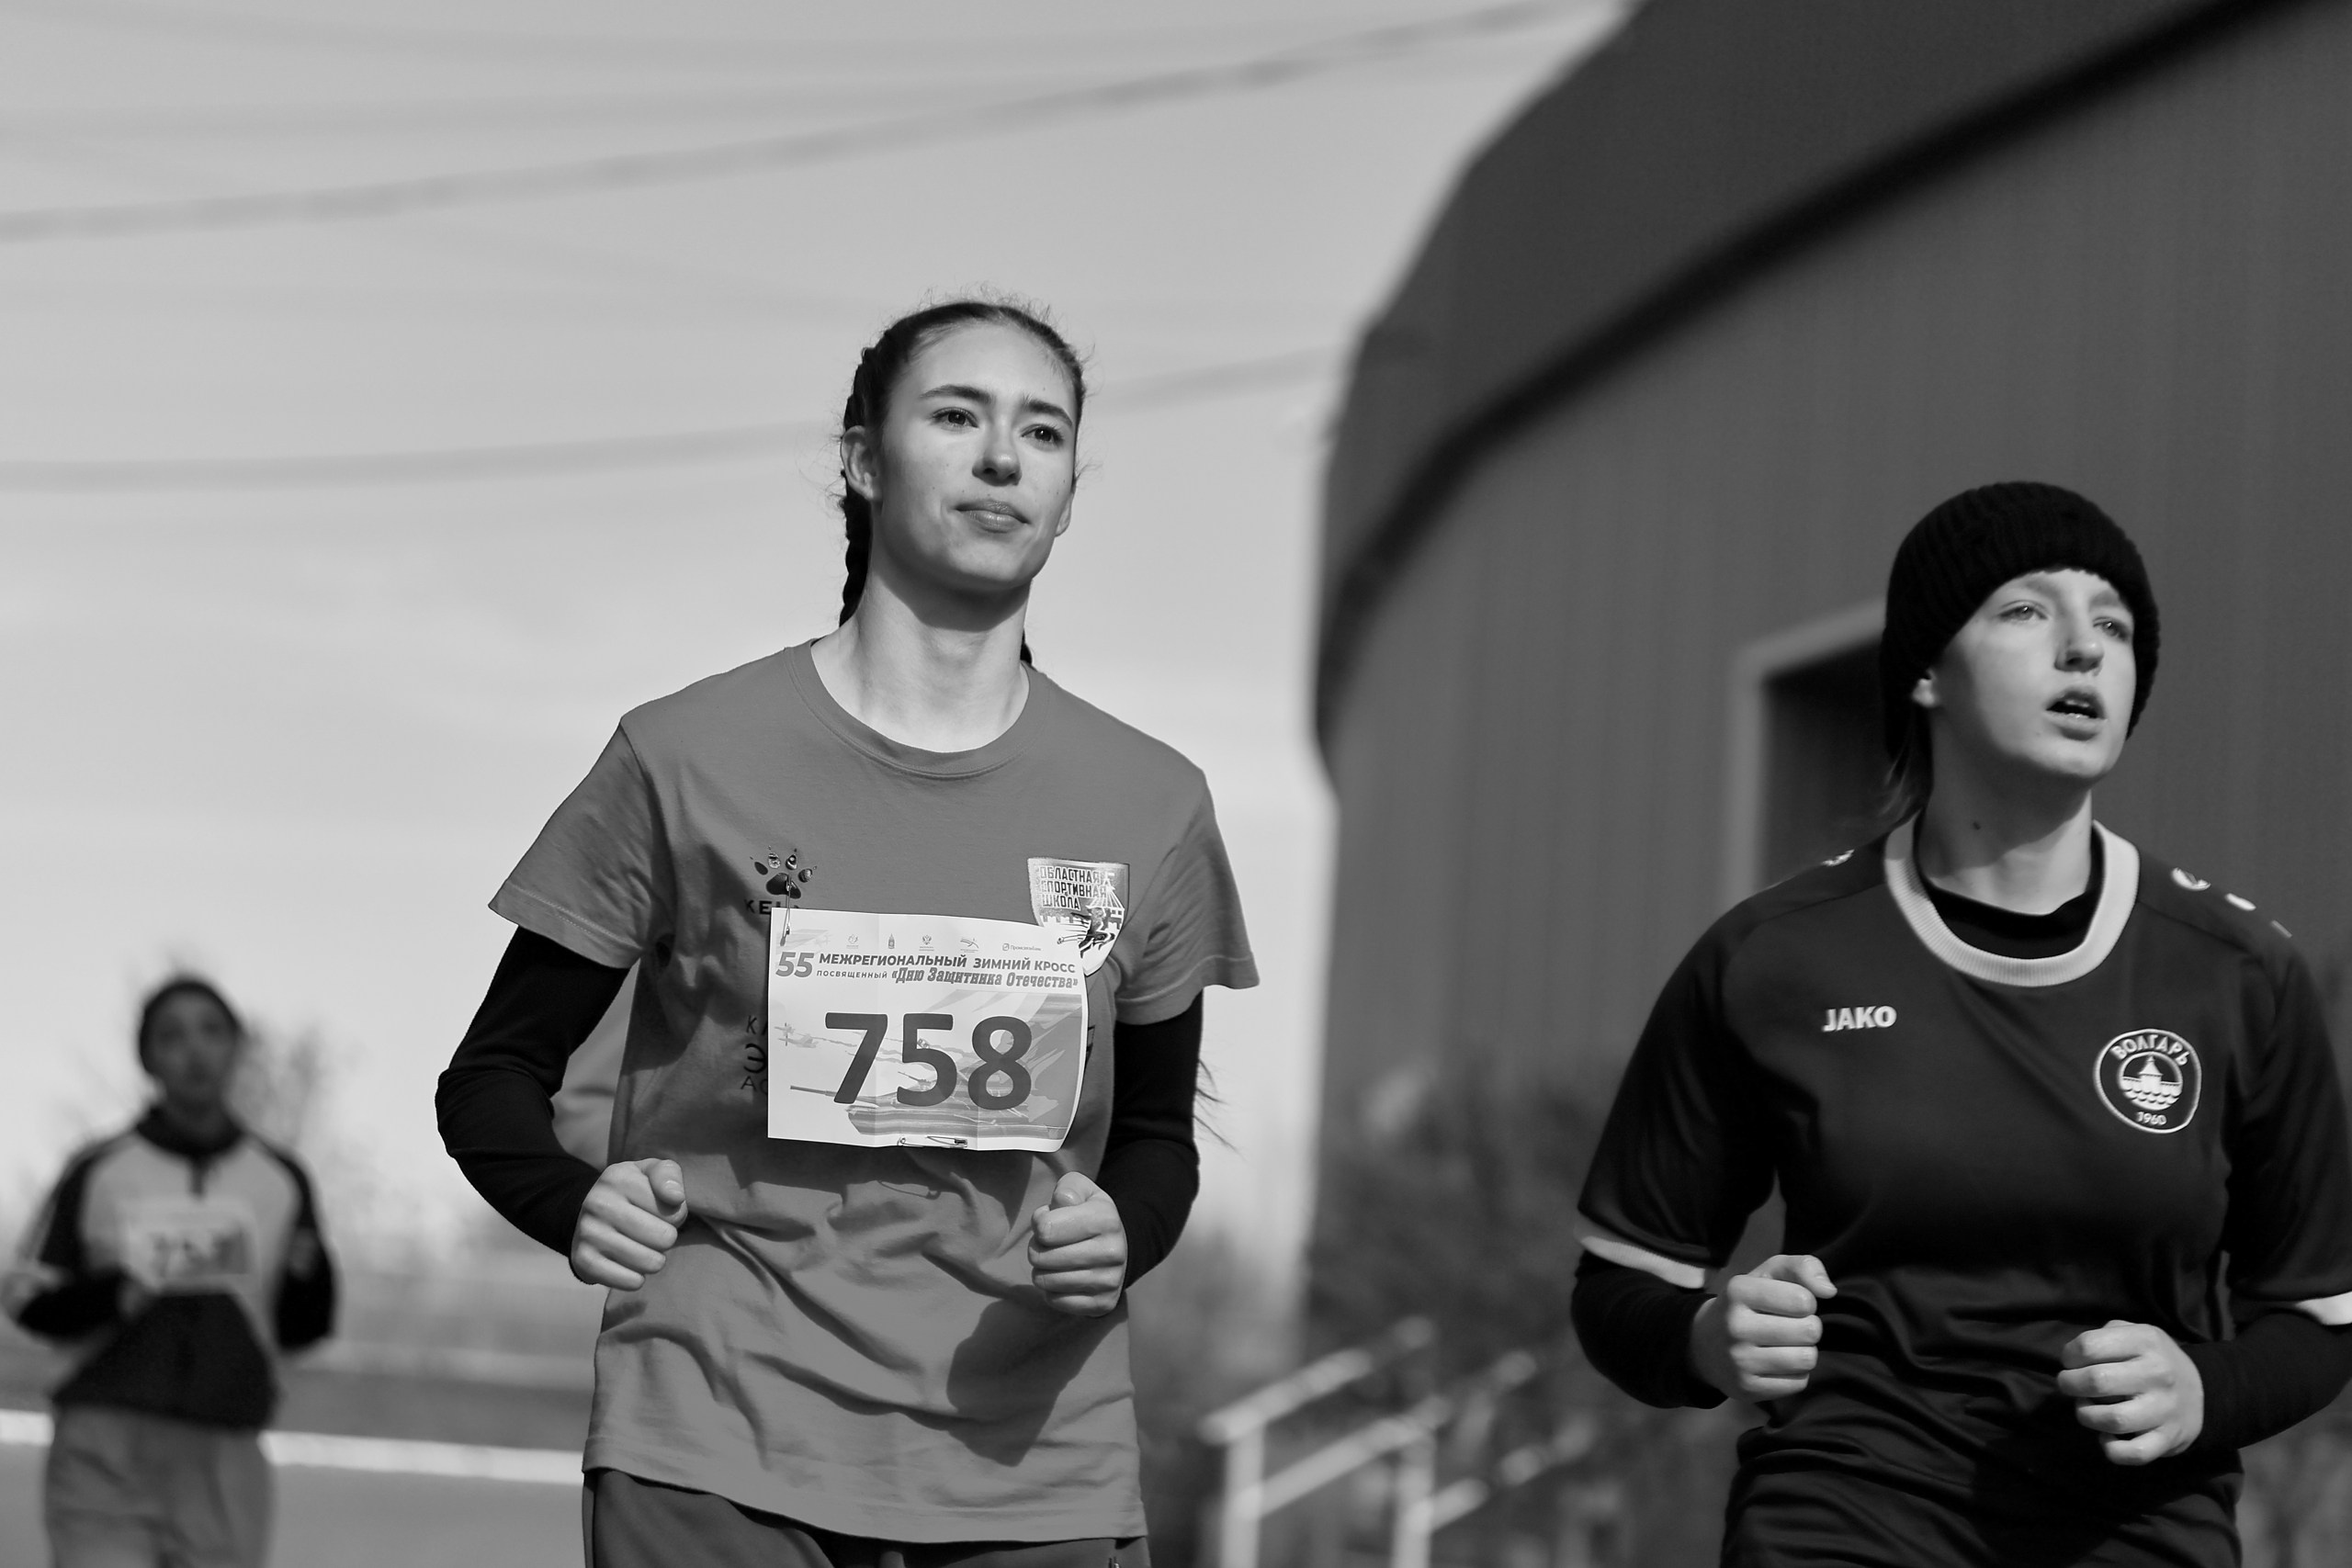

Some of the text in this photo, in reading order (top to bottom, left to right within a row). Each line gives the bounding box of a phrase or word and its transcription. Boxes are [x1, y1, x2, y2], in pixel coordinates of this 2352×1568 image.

[1040, 867, 1100, 884] ОБЛАСТНАЯ
[1042, 895, 1080, 910] ШКОЛА
[775, 952, 1076, 977] 55 МЕЖРЕГИОНАЛЬНЫЙ ЗИМНИЙ КРОСС
[817, 967, 1079, 989] ПОСВЯЩЕННЫЙ «Дню Защитника Отечества»
[1823, 1005, 1897, 1032] JAKO
[825, 1012, 1033, 1111] 758
[2111, 1034, 2190, 1066] ВОЛГАРЬ
[2137, 1111, 2167, 1126] 1960
